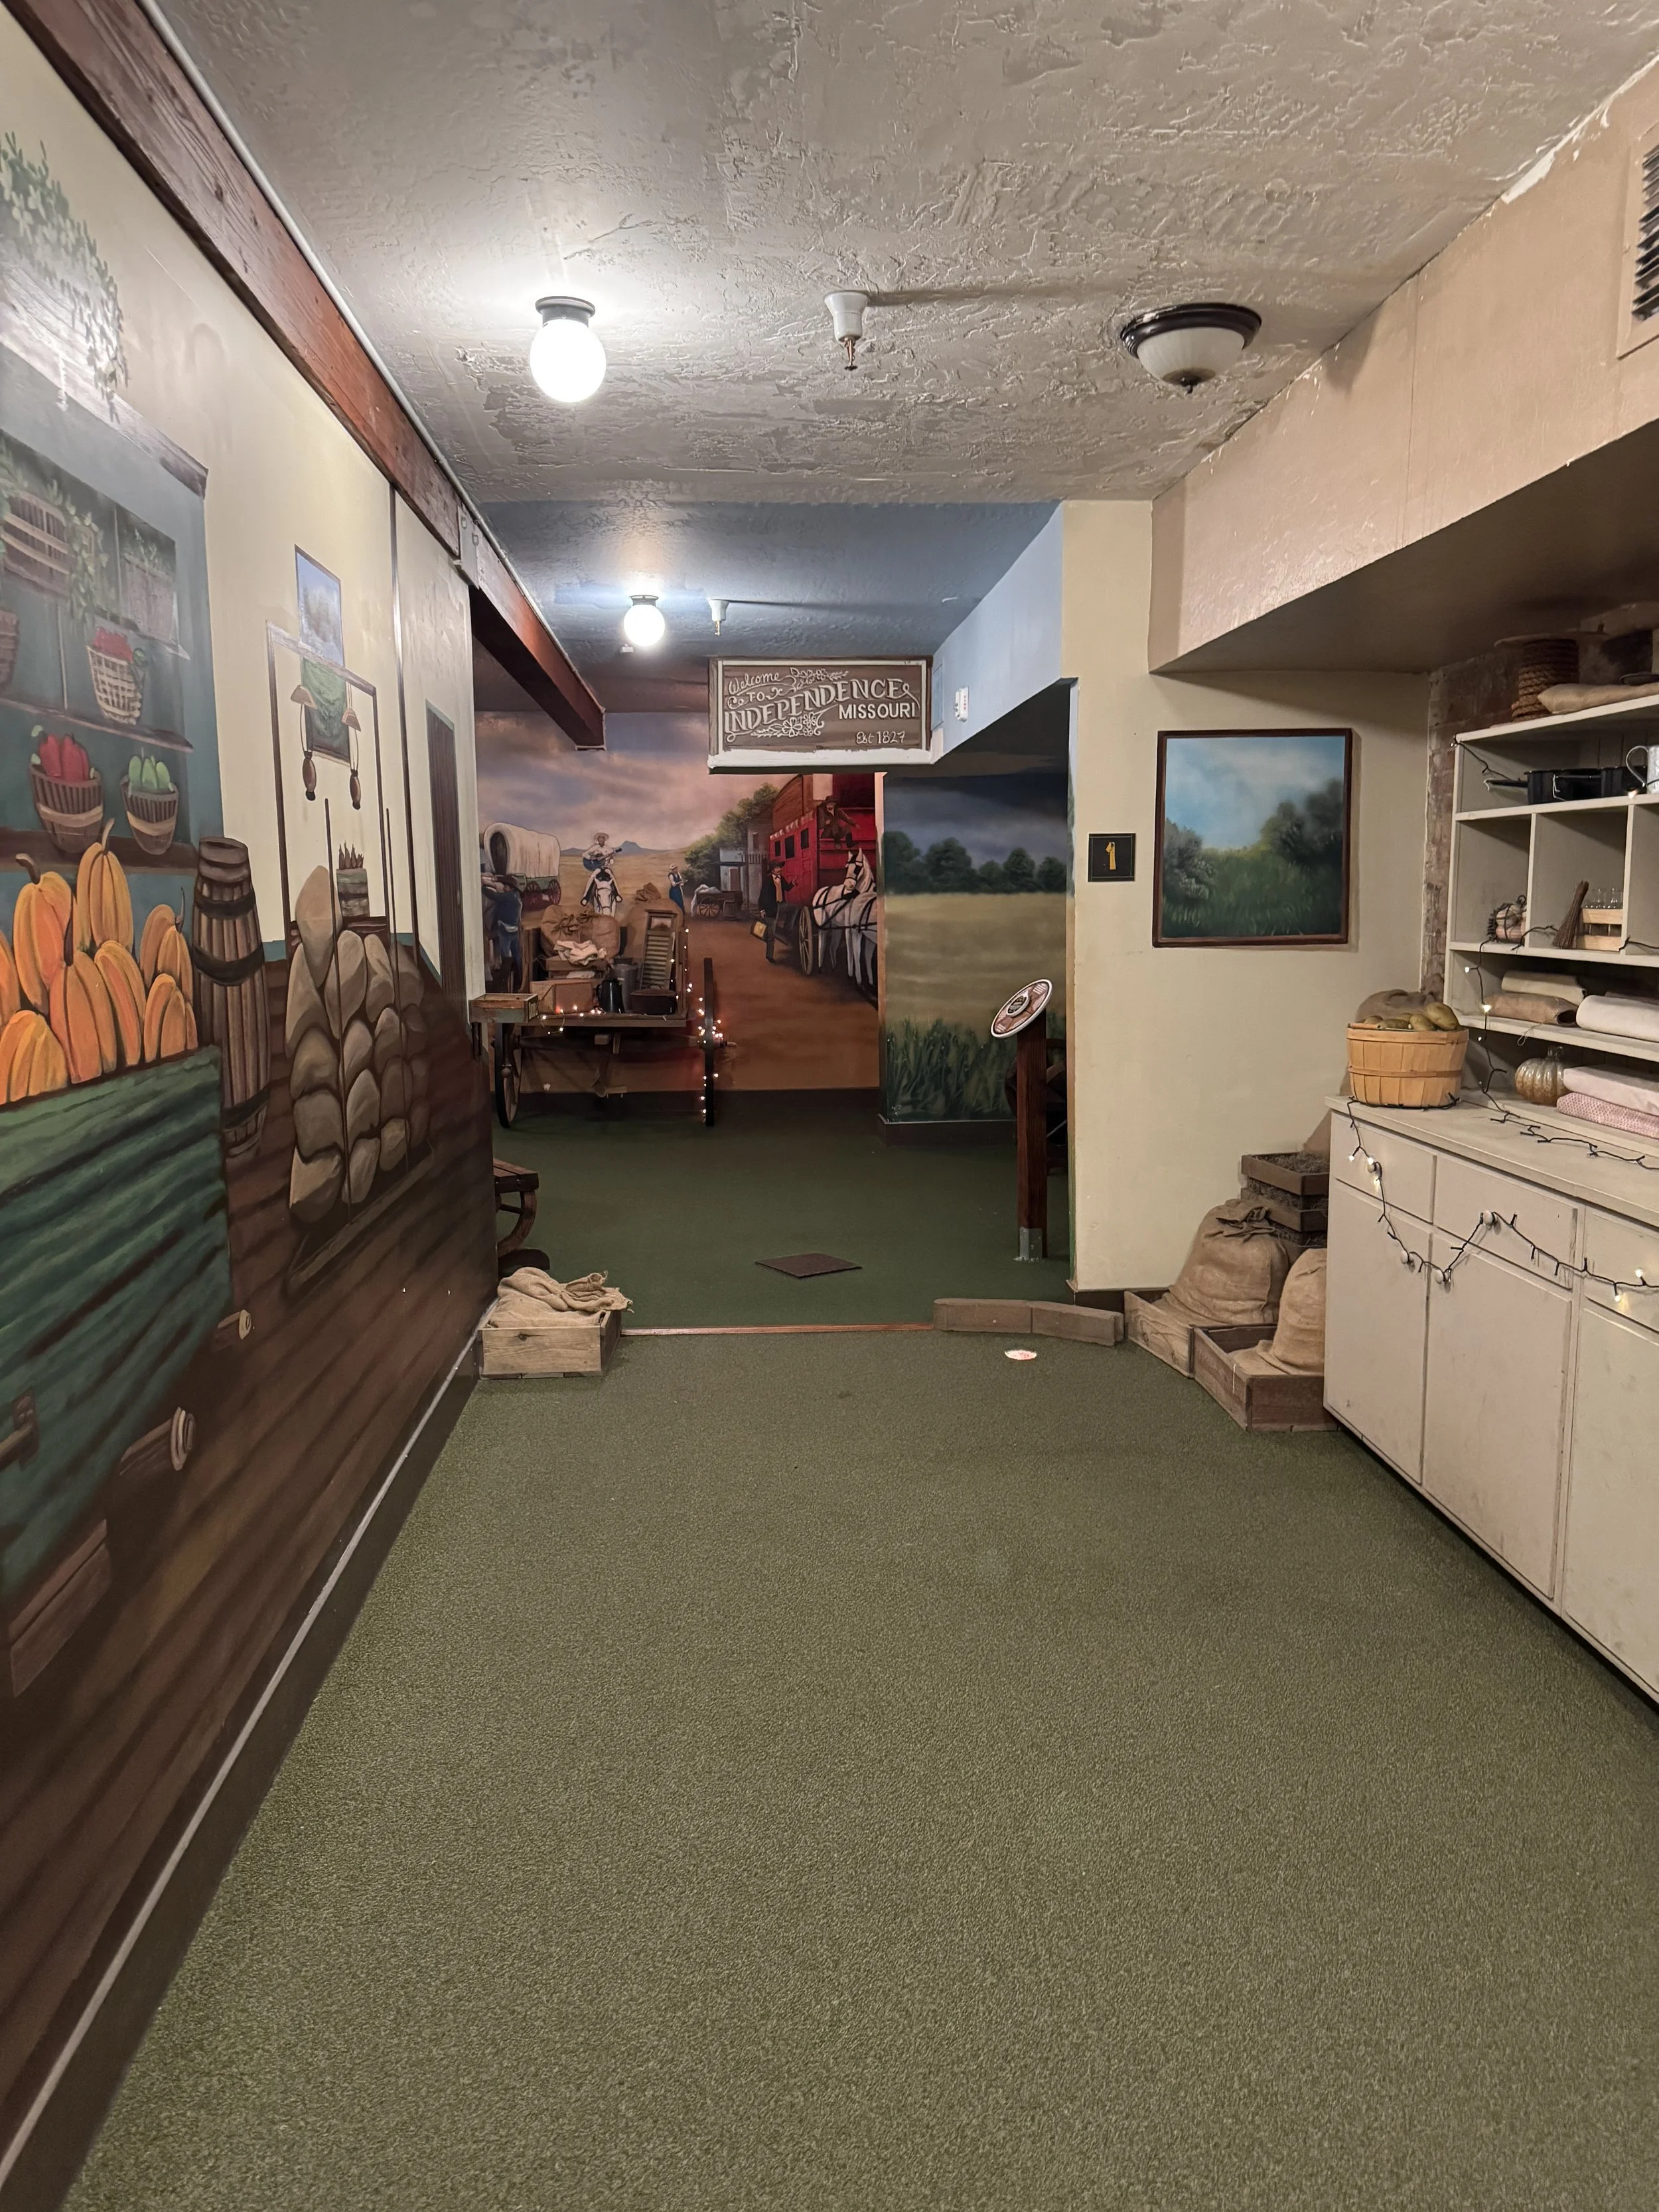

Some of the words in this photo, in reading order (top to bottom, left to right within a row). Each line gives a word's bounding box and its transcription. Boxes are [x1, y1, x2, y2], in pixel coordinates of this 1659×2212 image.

[729, 672, 780, 695] Welcome
[725, 678, 912, 735] INDEPENDENCE
[749, 692, 765, 702] TO
[839, 702, 916, 719] MISSOURI
[877, 731, 905, 745] 1827
[1106, 842, 1116, 870] 1
